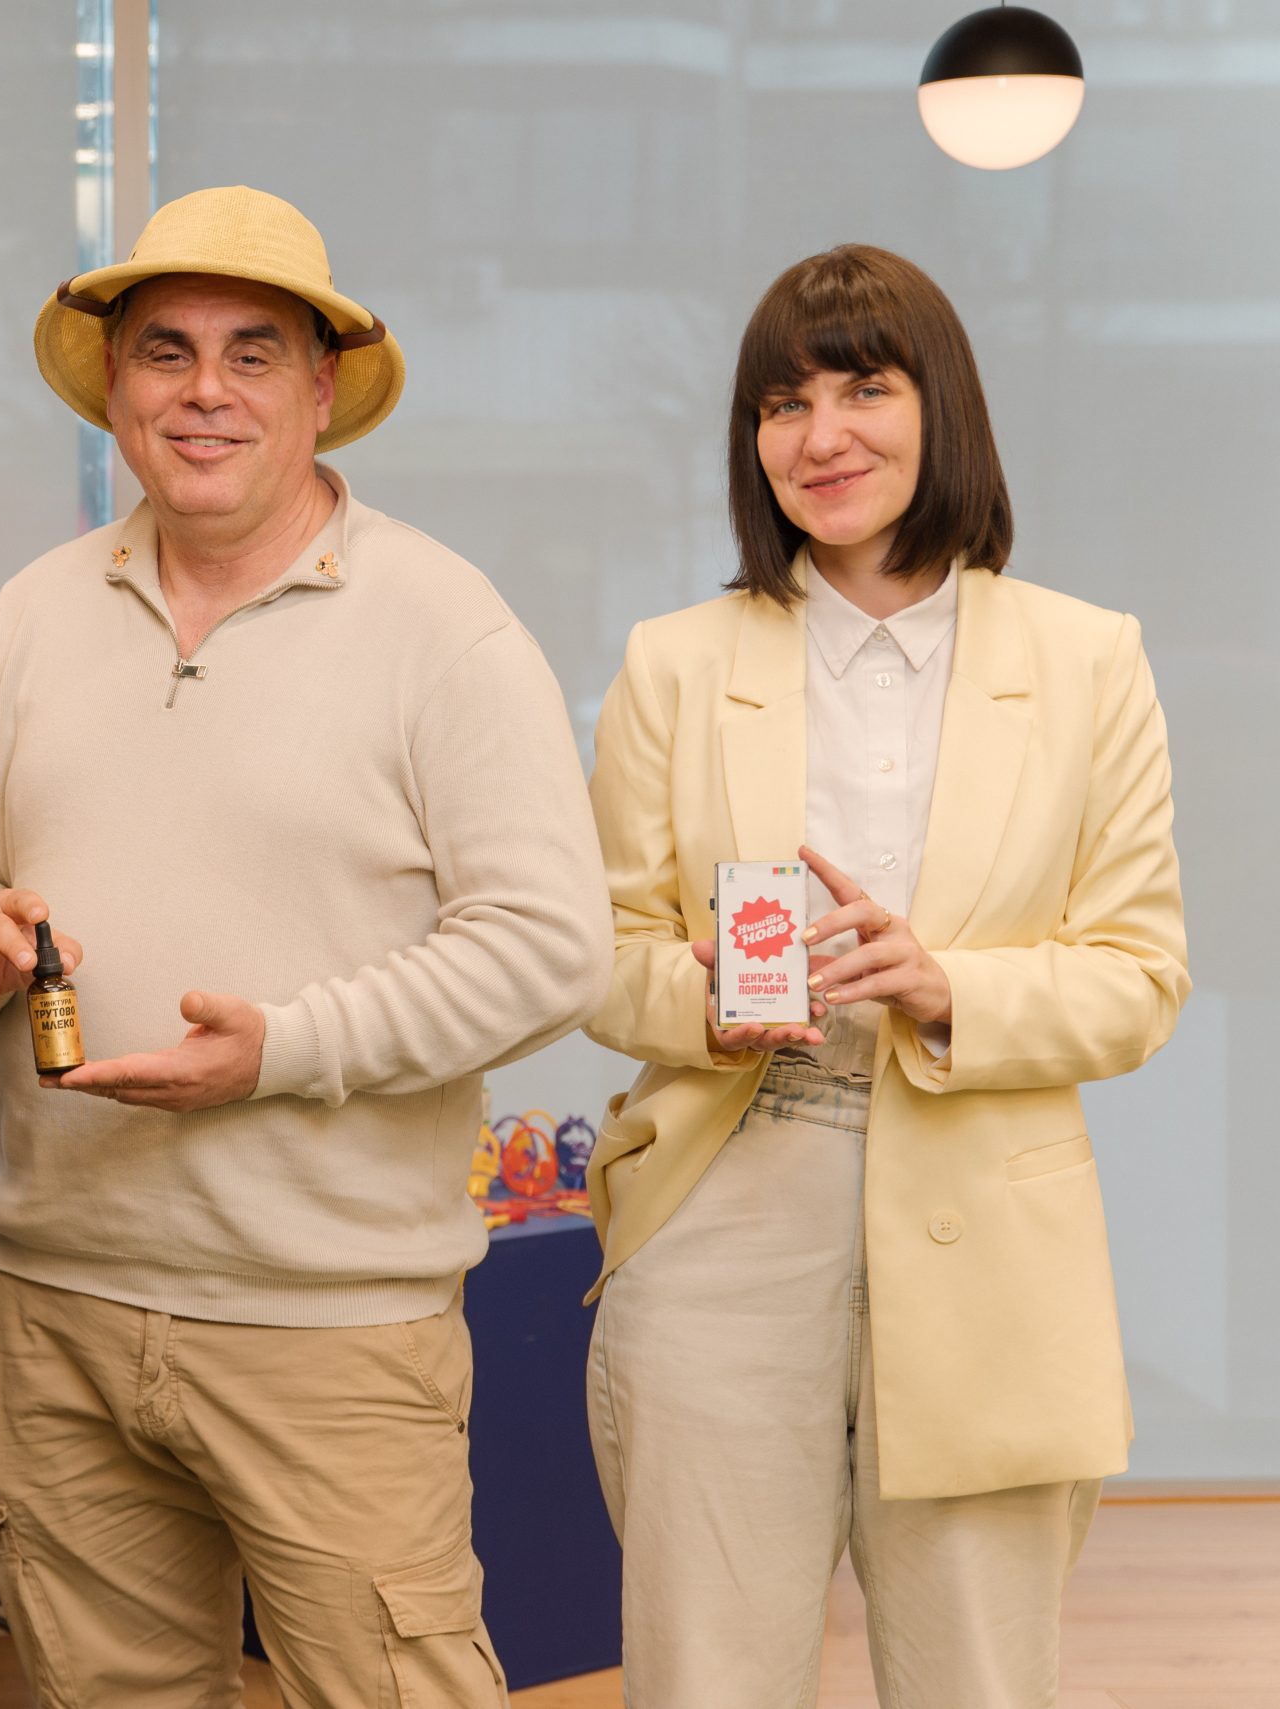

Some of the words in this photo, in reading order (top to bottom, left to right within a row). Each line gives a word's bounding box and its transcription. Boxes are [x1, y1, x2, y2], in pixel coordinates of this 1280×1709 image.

[737, 914, 785, 936] Ништо
[738, 973, 774, 984] ЦЕНТАР
[776, 973, 788, 983] ЗА
[738, 985, 789, 995] ПОПРАВКИ
[40, 998, 72, 1008] ТИНКТУРА
[34, 1006, 76, 1020] ТРУТОВО
[41, 1018, 75, 1031] МЛЕКО
